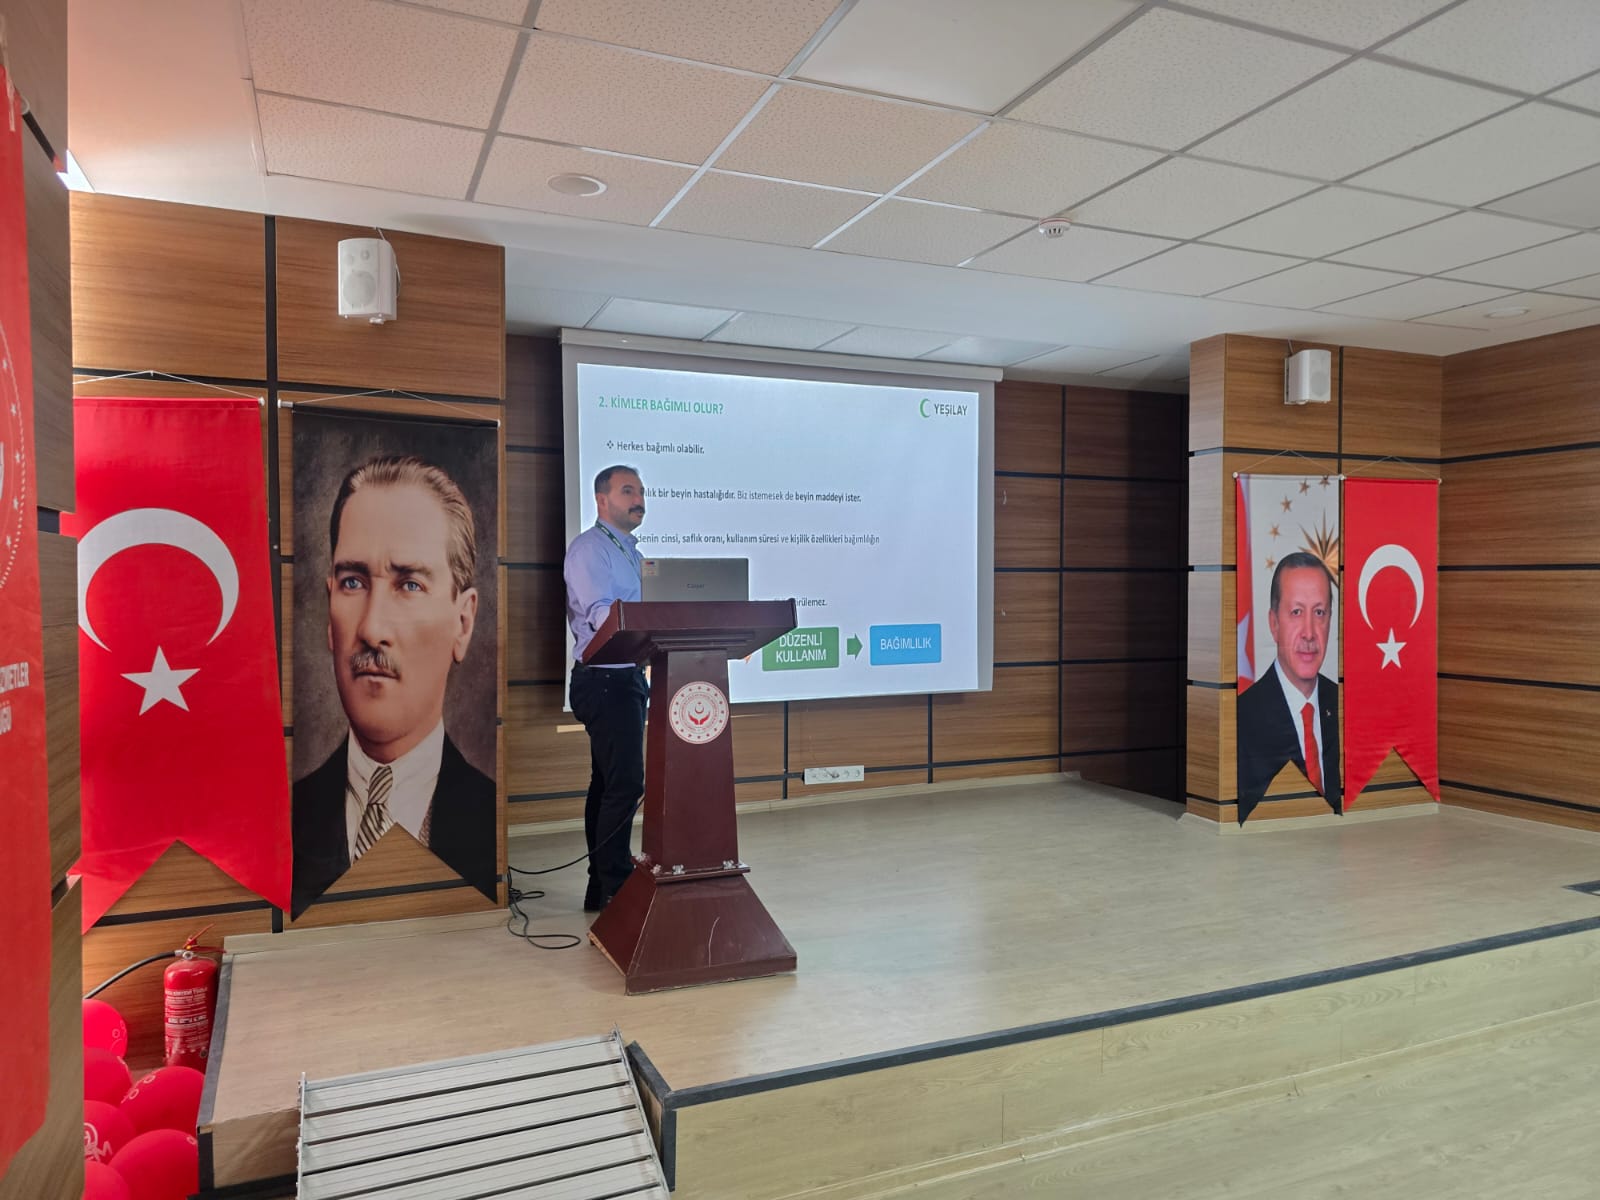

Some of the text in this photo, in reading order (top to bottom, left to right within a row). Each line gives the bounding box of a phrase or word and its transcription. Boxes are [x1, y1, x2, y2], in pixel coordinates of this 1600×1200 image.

[599, 395, 724, 415] 2. KİMLER BAĞIMLI OLUR?
[934, 403, 968, 416] YEŞİLAY
[617, 441, 705, 455] Herkes bağımlı olabilir.
[658, 488, 669, 498] bir
[670, 488, 692, 500] beyin
[737, 490, 748, 500] Biz
[749, 490, 783, 501] istemesek
[784, 490, 794, 501] de
[795, 491, 814, 503] beyin
[815, 492, 844, 504] maddeyi
[661, 533, 681, 545] cinsi,
[682, 533, 703, 543] saflık
[703, 535, 725, 545] oranı,
[726, 533, 758, 544] kullanım
[758, 534, 780, 544] süresi
[780, 535, 790, 544] ve
[790, 533, 810, 545] kişilik
[811, 533, 843, 545] özellikleri
[779, 631, 823, 648] DÜZENLİ
[880, 636, 932, 651] BAĞIMLILIK
[775, 649, 827, 663] KULLANIM
